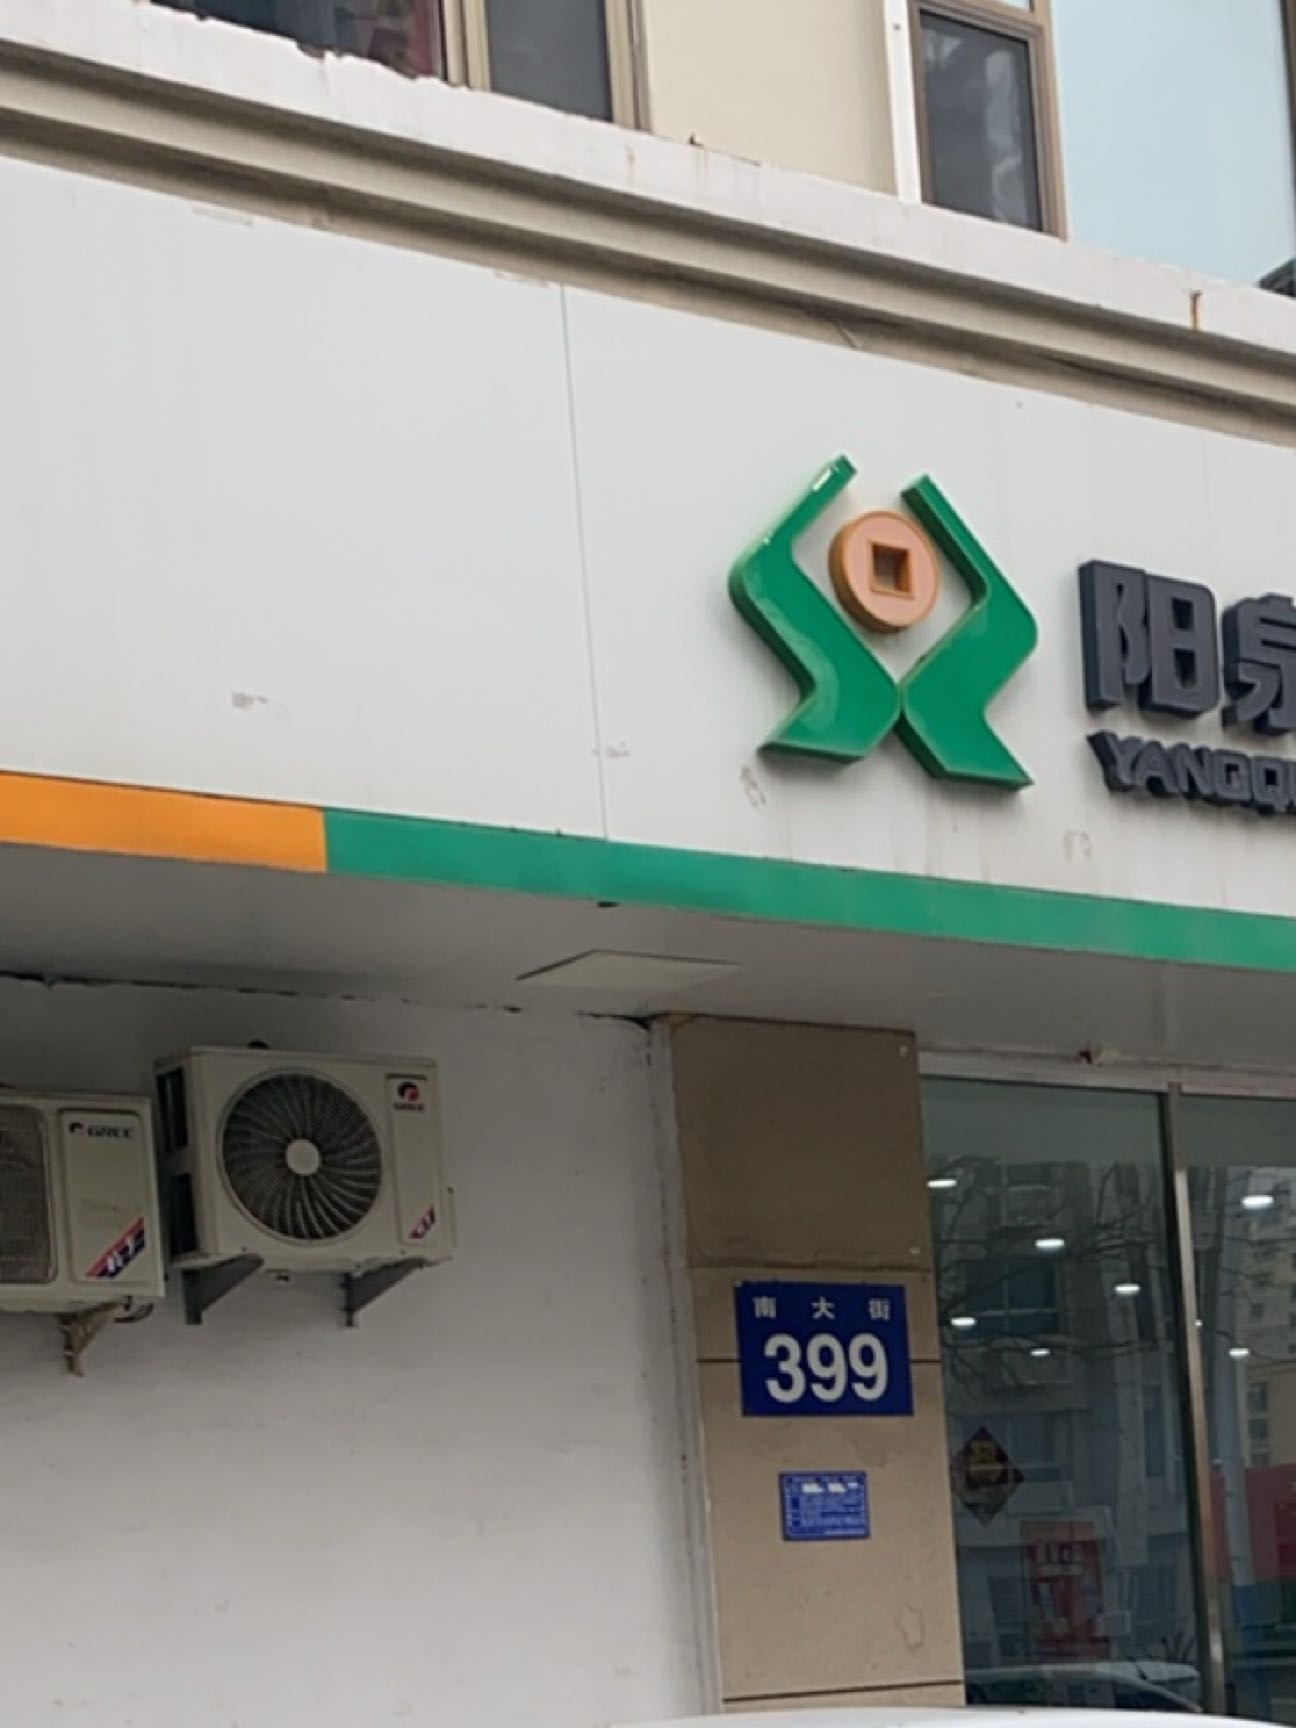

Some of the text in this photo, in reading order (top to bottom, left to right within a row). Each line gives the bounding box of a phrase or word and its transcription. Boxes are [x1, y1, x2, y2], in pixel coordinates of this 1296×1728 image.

[753, 1296, 891, 1320] 南大街
[764, 1333, 888, 1403] 399
